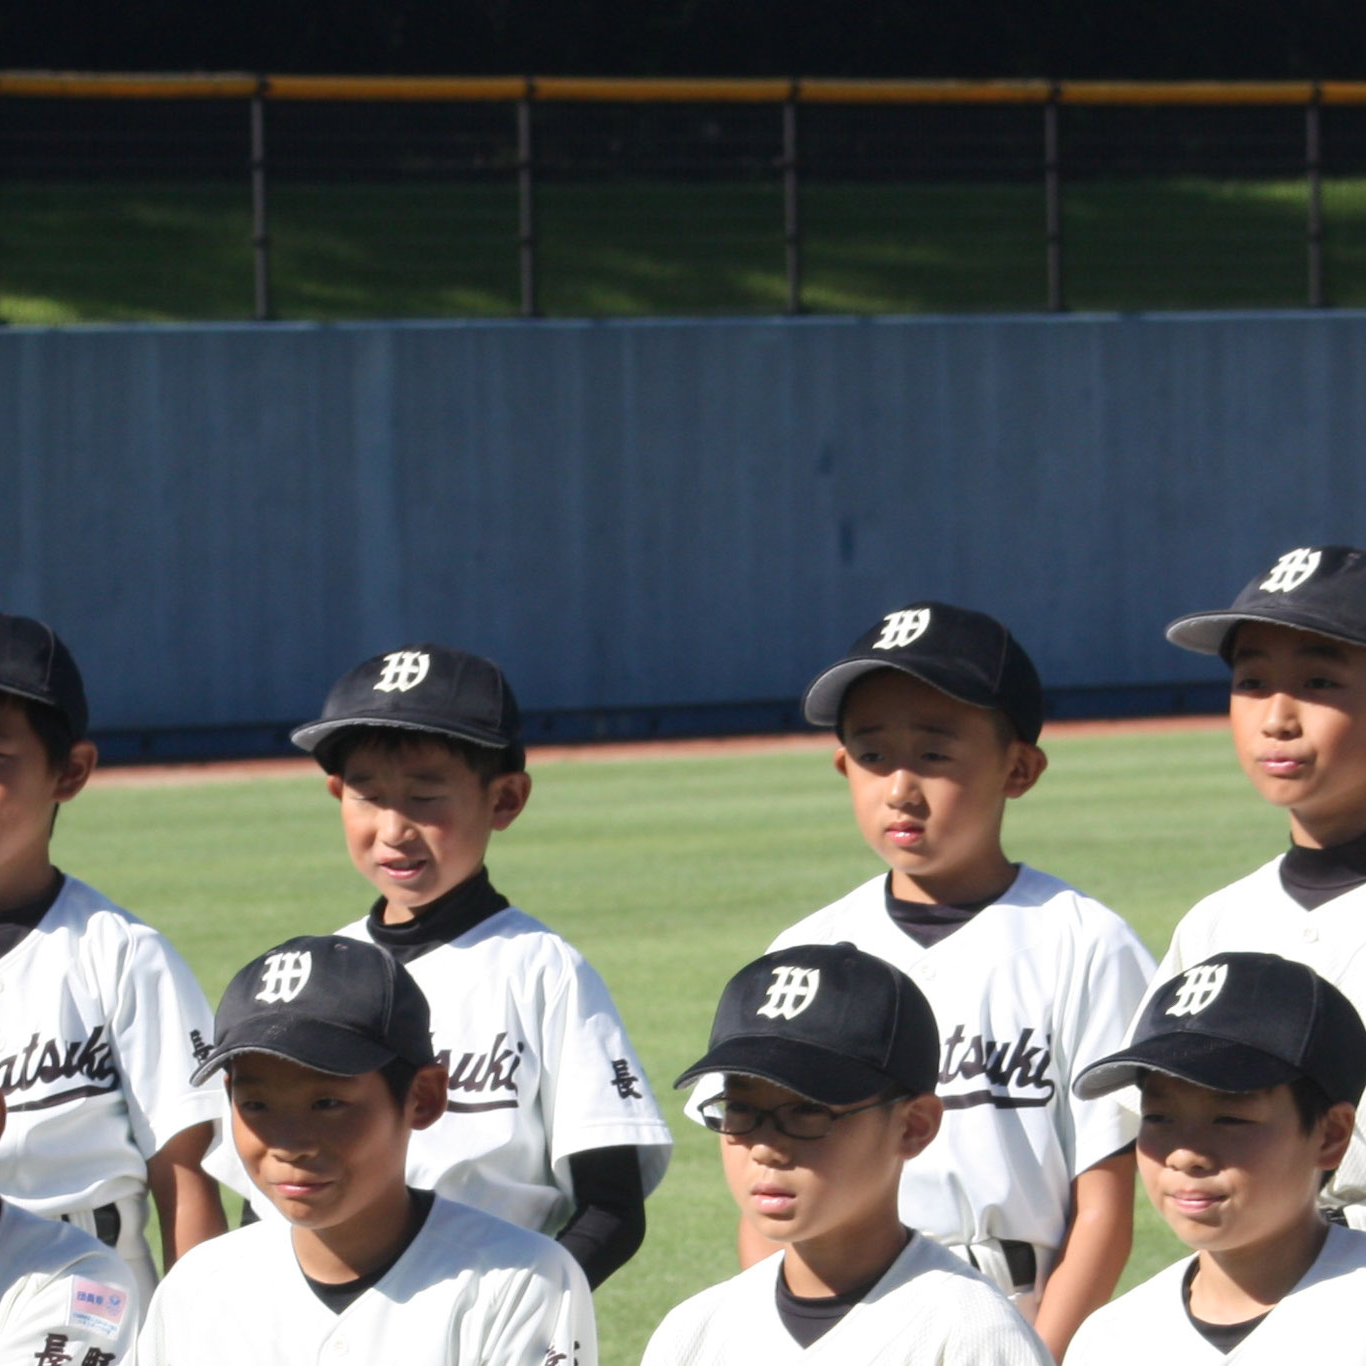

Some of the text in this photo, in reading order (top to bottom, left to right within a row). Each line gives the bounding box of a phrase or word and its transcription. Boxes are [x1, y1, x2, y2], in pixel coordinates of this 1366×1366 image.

[1259, 547, 1322, 593] W
[872, 608, 930, 650] W
[373, 651, 430, 692] W
[255, 951, 312, 1004] W
[756, 965, 820, 1020] W
[1166, 963, 1227, 1018] W
